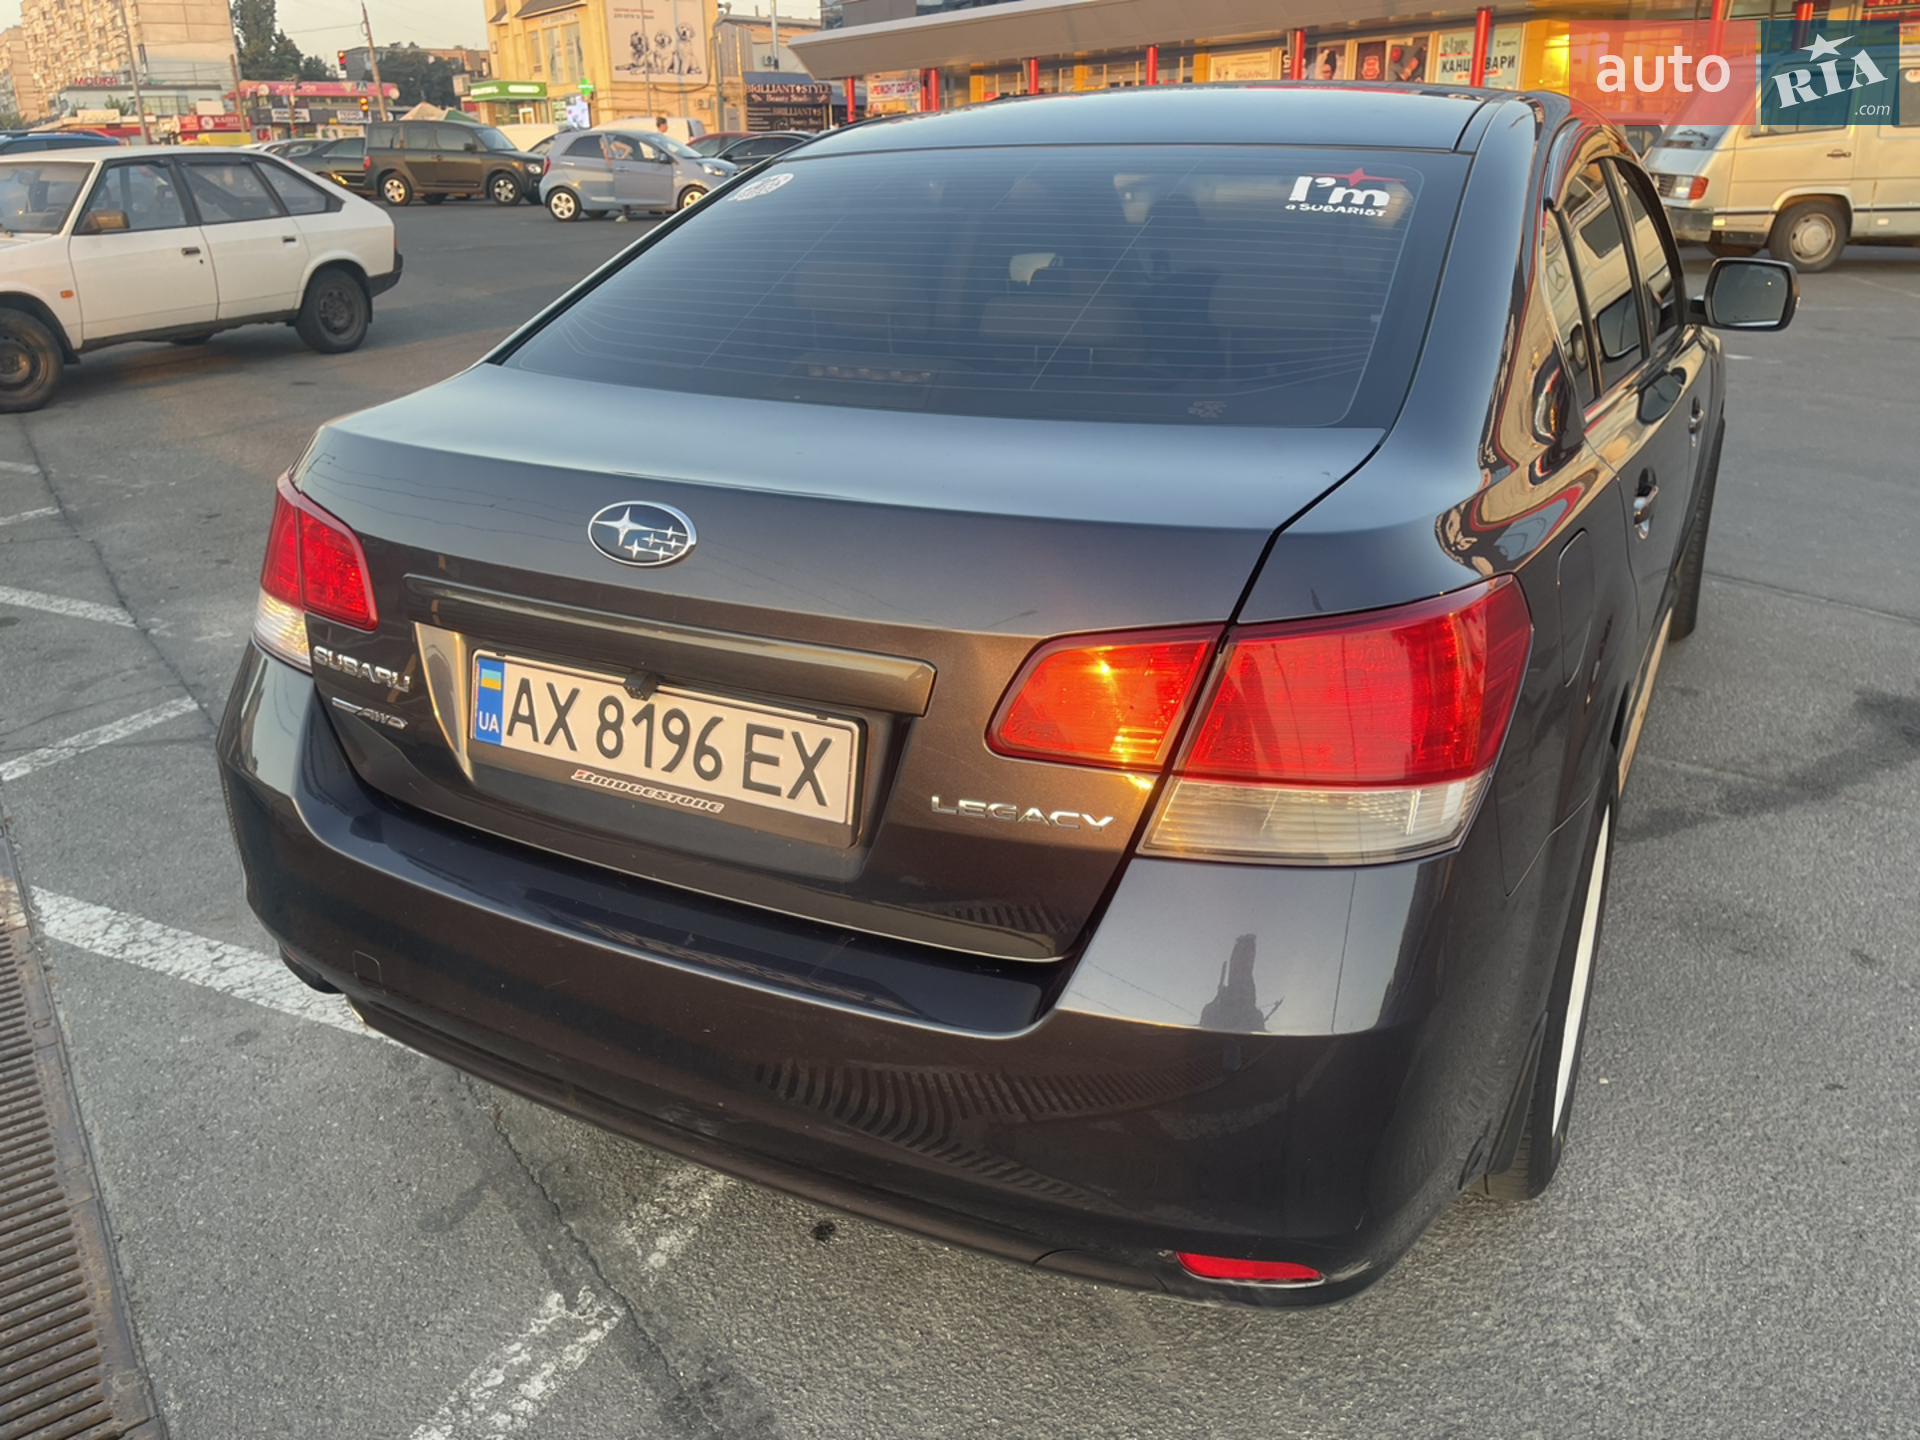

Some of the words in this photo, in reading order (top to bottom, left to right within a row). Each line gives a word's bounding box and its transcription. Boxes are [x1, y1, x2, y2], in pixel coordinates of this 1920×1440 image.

[747, 84, 795, 93] BRILLIANT
[801, 84, 830, 93] STYLE
[1289, 176, 1390, 206] I'm
[1299, 203, 1387, 216] SUBARIST
[313, 645, 411, 692] SUBARU
[479, 711, 500, 734] UA
[506, 677, 580, 752] AX
[596, 695, 724, 782] 8196
[743, 723, 833, 807] EX
[571, 769, 724, 813] BRIDGESTONE
[932, 795, 1114, 831] LEGACY
